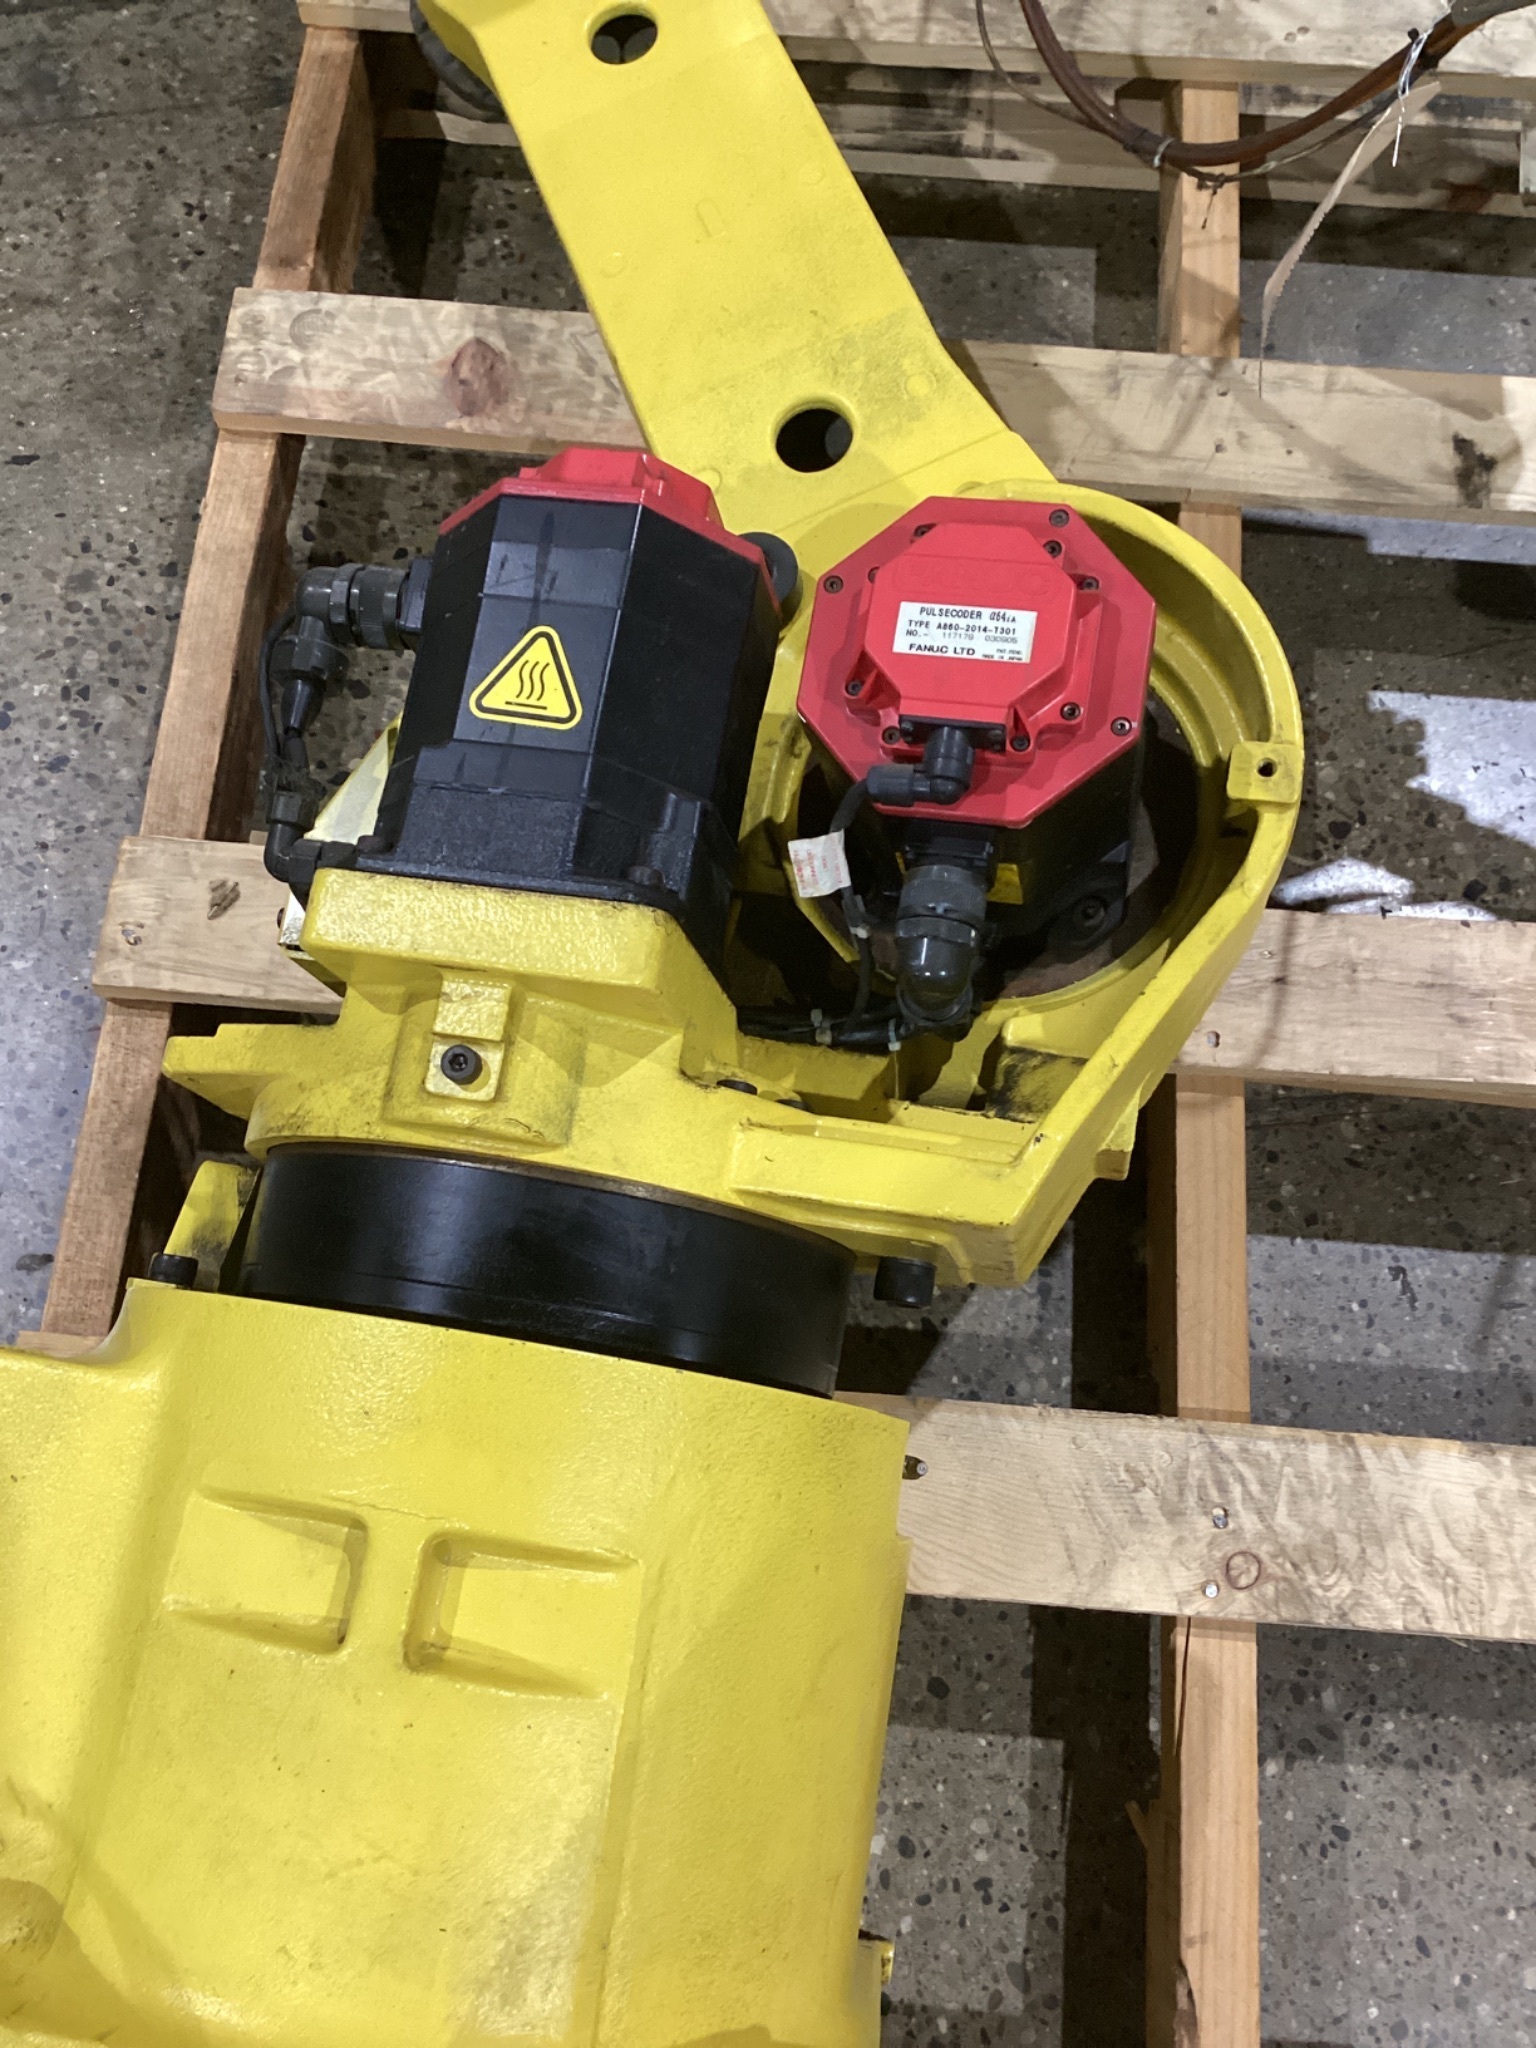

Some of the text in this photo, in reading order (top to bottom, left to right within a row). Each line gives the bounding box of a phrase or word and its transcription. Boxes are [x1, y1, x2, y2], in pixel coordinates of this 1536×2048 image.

[919, 606, 983, 620] PULSECODER
[907, 619, 1017, 636] TYPE A860-2014-T301
[908, 643, 976, 656] FANUC LTD
